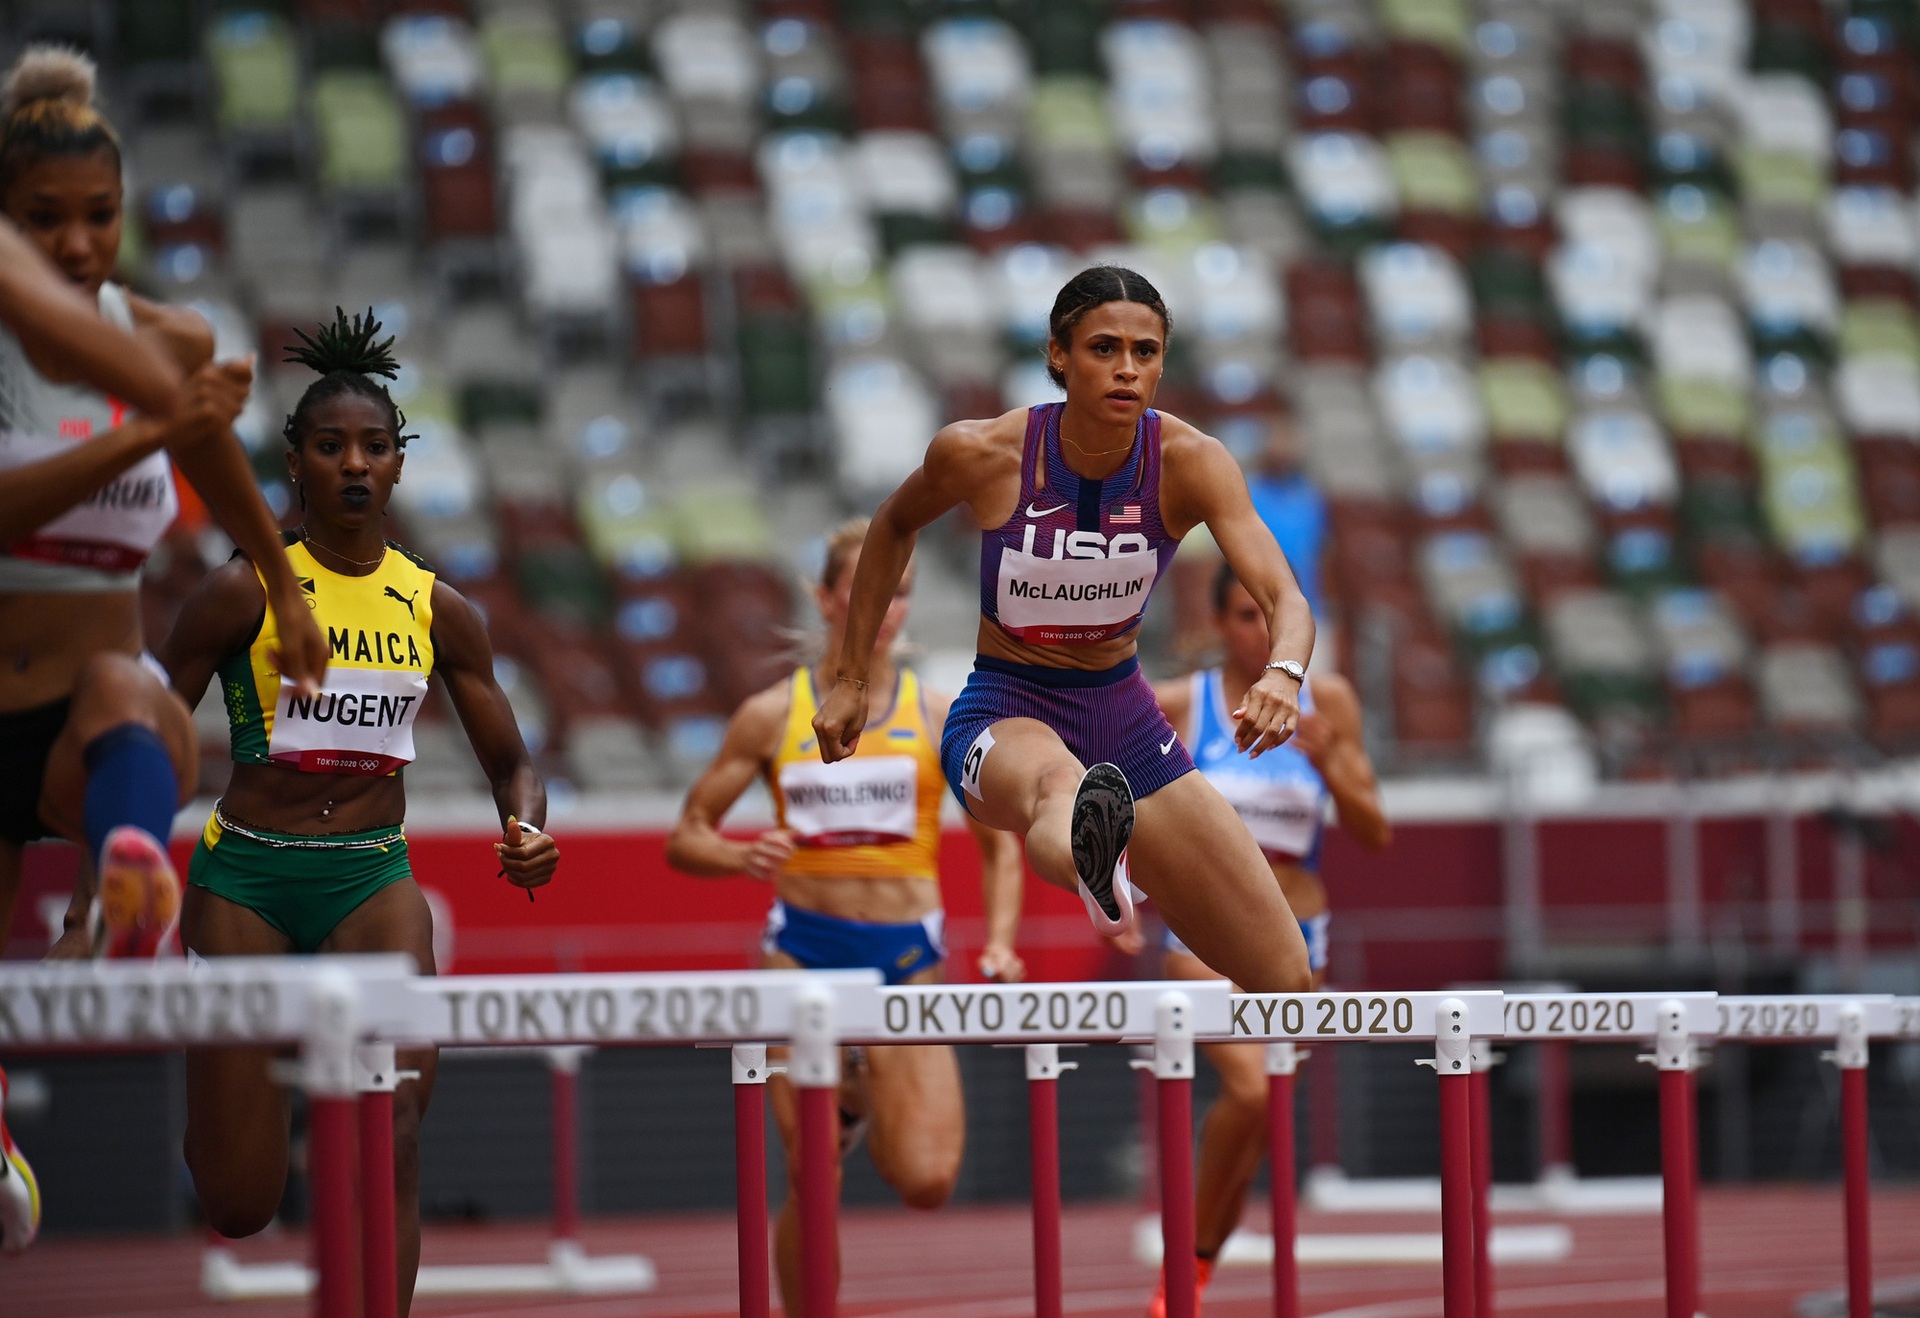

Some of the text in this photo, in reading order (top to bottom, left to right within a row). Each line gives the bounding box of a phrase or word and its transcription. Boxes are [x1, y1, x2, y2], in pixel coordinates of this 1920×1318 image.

[1022, 524, 1148, 560] USA
[1009, 578, 1144, 601] McLAUGHLIN
[328, 626, 422, 668] MAICA
[1039, 631, 1083, 640] TOKYO 2020
[286, 693, 417, 728] NUGENT
[316, 757, 357, 768] TOKYO 2020
[964, 744, 983, 785] 5
[126, 979, 281, 1039] 2020
[443, 985, 760, 1043] TOKYO 2020
[884, 991, 1127, 1033] OKYO 2020
[1233, 997, 1413, 1035] KYO 2020
[1547, 1000, 1634, 1032] 2020
[1737, 1003, 1820, 1036] 2020
